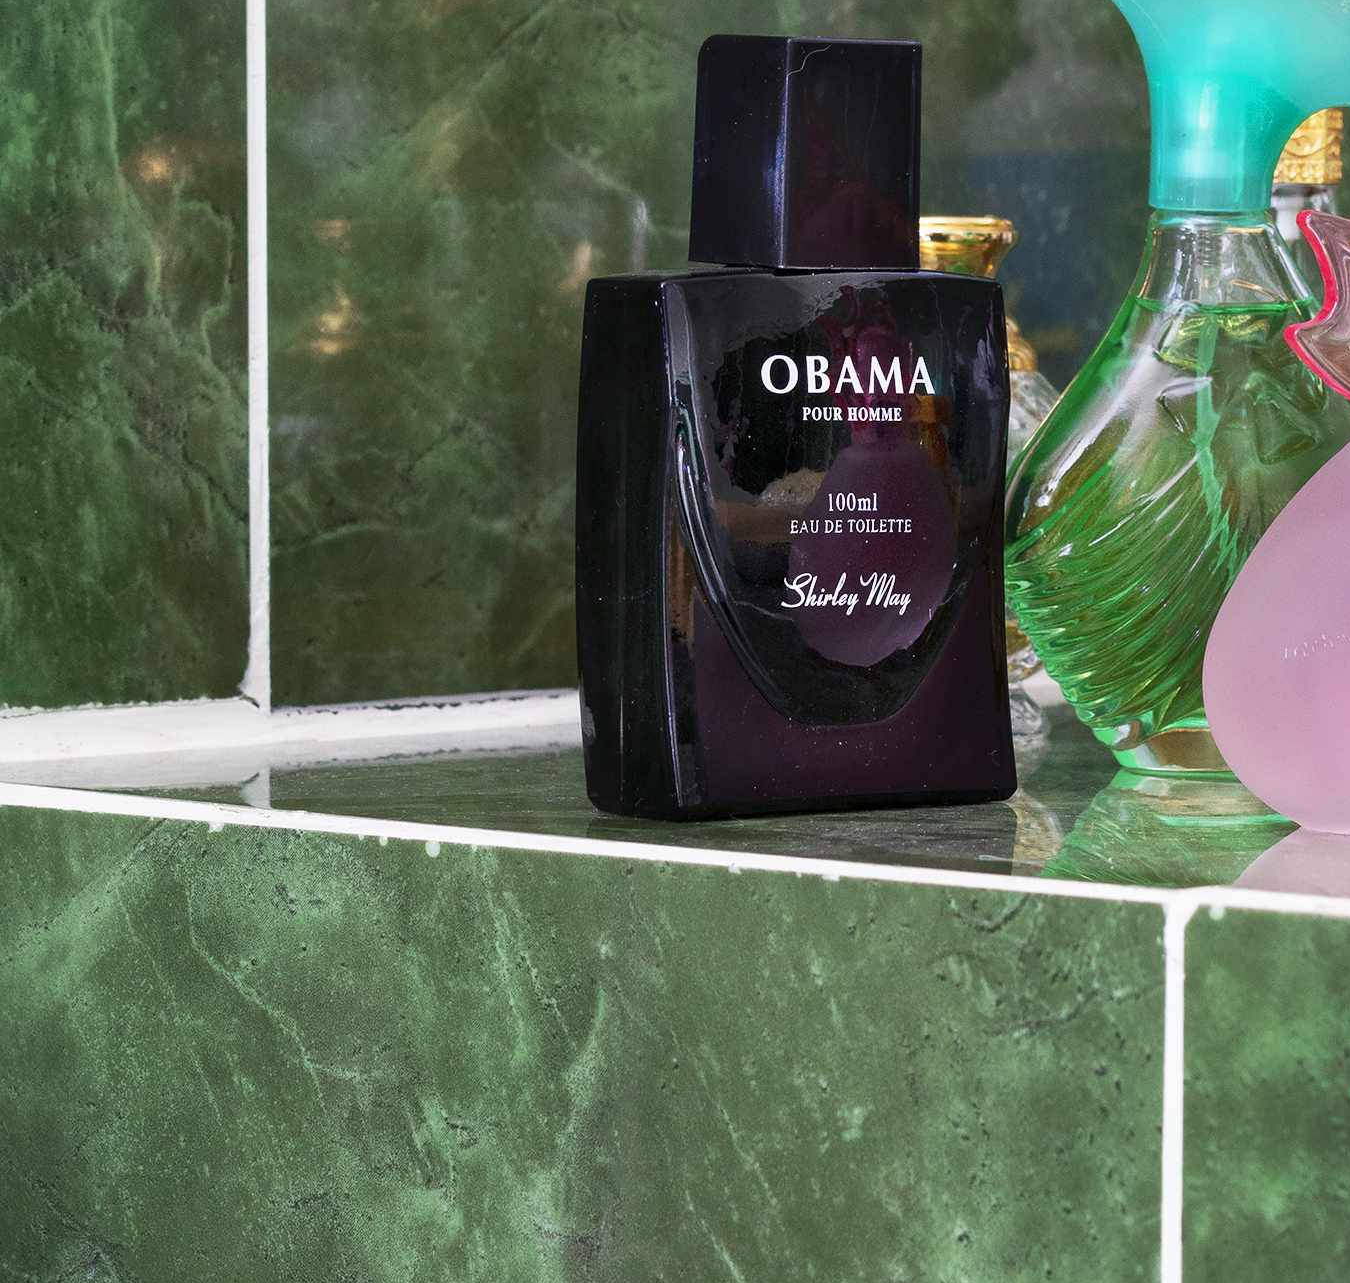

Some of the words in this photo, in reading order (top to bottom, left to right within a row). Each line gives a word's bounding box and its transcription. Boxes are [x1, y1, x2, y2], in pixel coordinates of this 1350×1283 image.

[760, 354, 936, 394] OBAMA
[802, 406, 843, 422] POUR
[847, 406, 903, 422] HOMME
[828, 492, 878, 512] 100ml
[789, 519, 820, 534] EAU
[824, 519, 843, 534] DE
[847, 518, 912, 533] TOILETTE
[780, 572, 860, 616] Shirley
[859, 572, 912, 616] May
